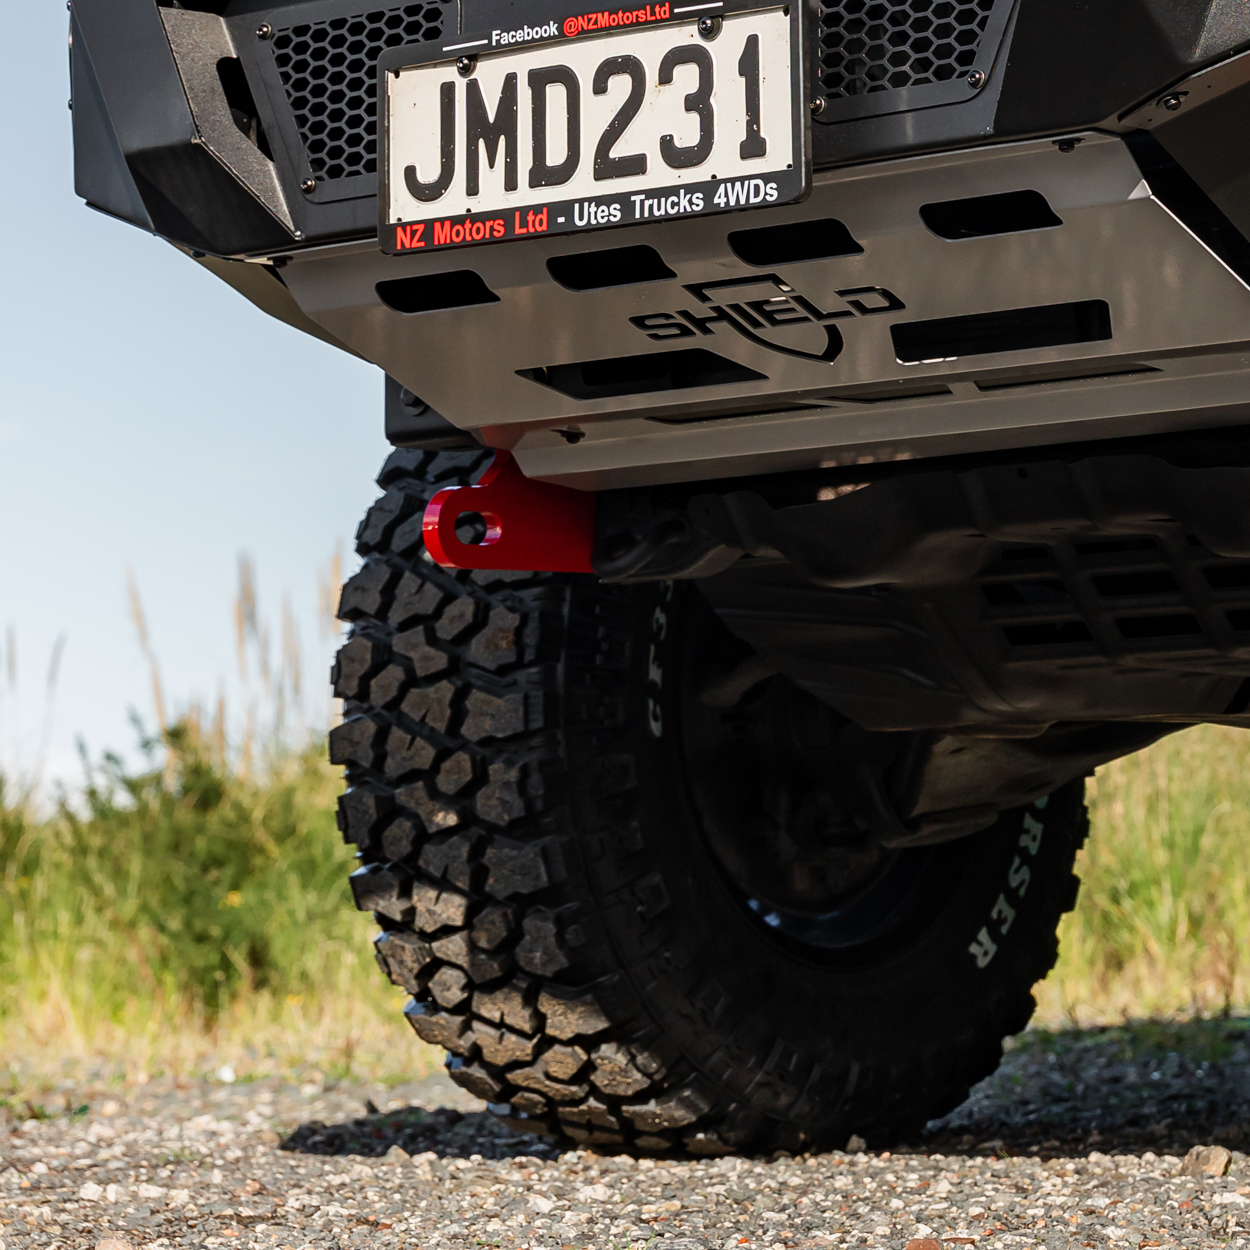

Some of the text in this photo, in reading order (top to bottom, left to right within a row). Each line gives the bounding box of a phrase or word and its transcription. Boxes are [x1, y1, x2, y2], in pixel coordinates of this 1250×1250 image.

[491, 2, 670, 46] Facebook @NZMotorsLtd
[403, 33, 767, 203] JMD231
[396, 223, 426, 250] NZ
[433, 218, 505, 245] Motors
[514, 207, 548, 235] Ltd
[574, 201, 621, 227] Utes
[630, 189, 704, 219] Trucks
[713, 179, 778, 208] 4WDs
[628, 285, 906, 341] SHIELD
